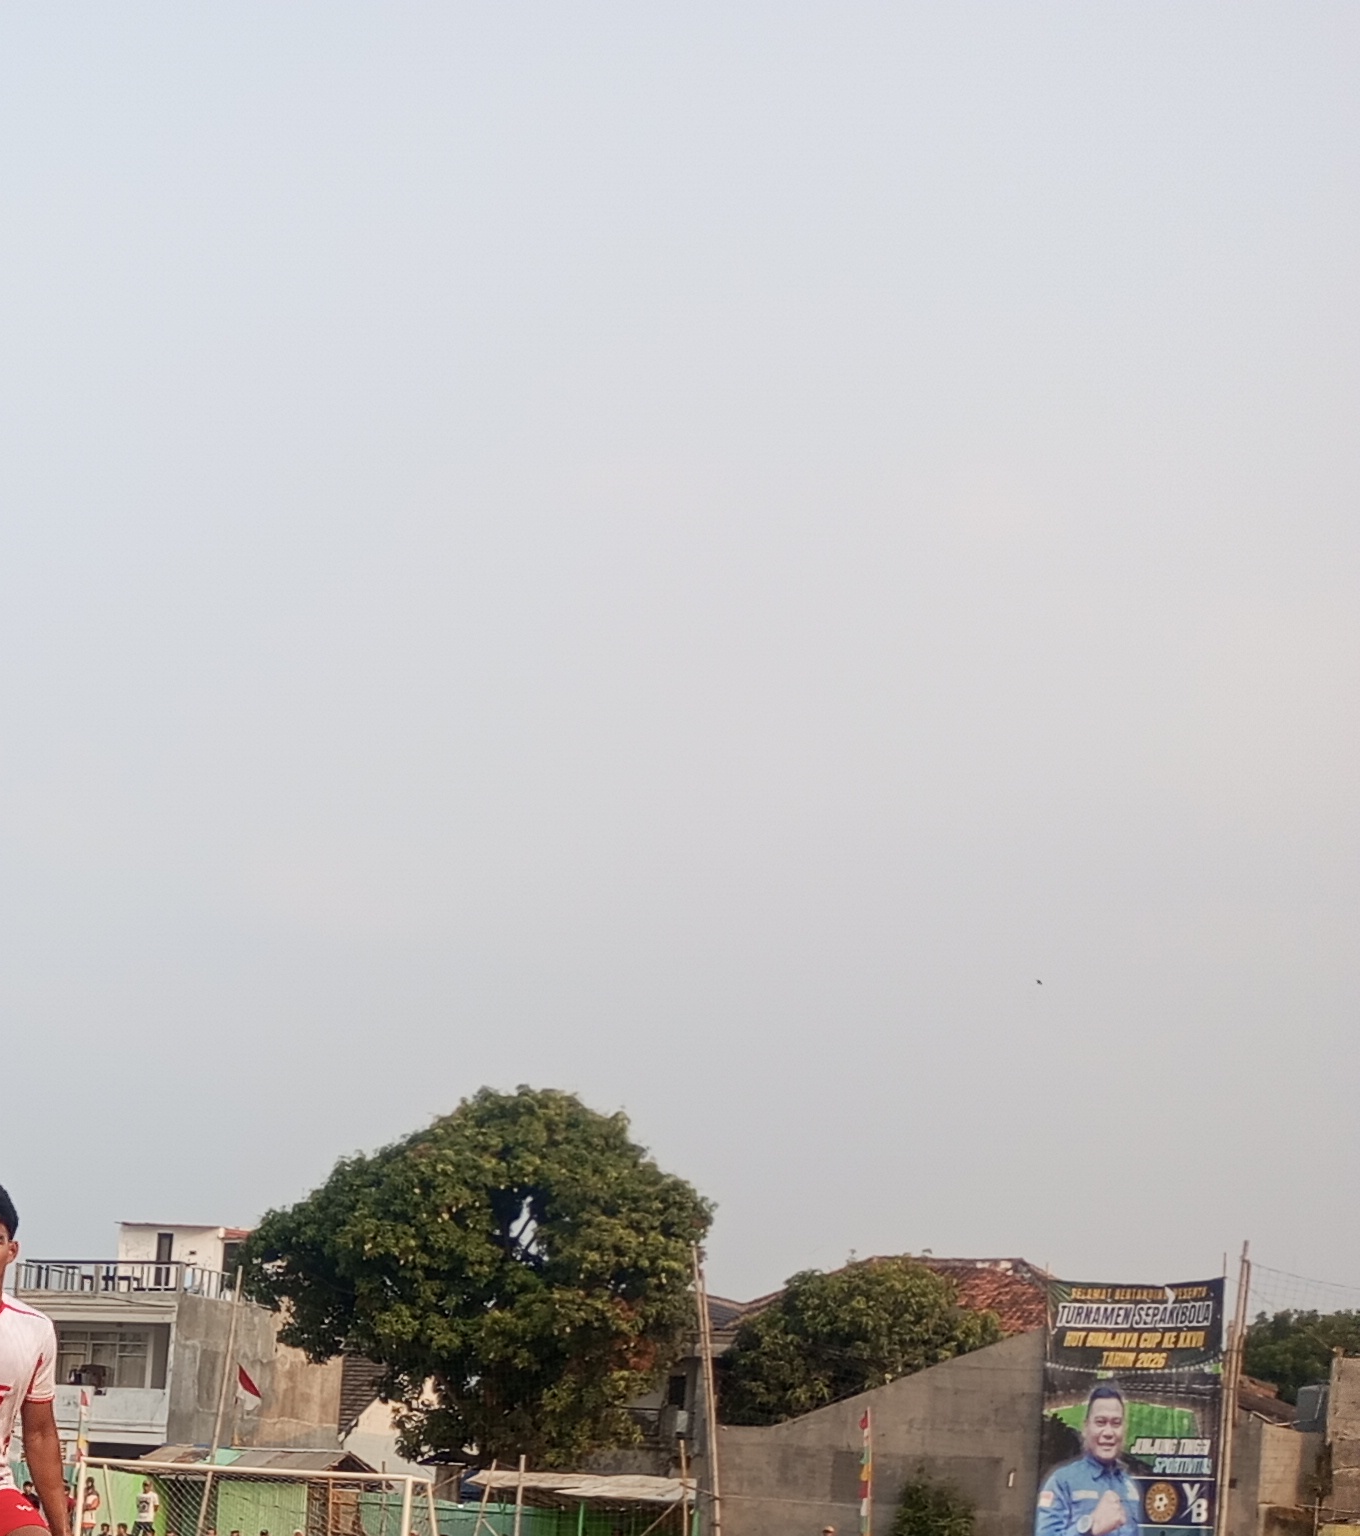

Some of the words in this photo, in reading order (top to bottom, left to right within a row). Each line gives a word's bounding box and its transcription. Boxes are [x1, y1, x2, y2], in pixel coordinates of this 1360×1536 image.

[1071, 1287, 1112, 1300] SELAMAT
[1057, 1303, 1135, 1327] TURNAMEN
[1133, 1304, 1179, 1328] SEPAK
[1177, 1301, 1212, 1326] BOLA
[1064, 1331, 1087, 1347] HUT
[1139, 1332, 1162, 1348] CUP
[1162, 1331, 1178, 1348] KE
[1102, 1351, 1136, 1368] TAHUN
